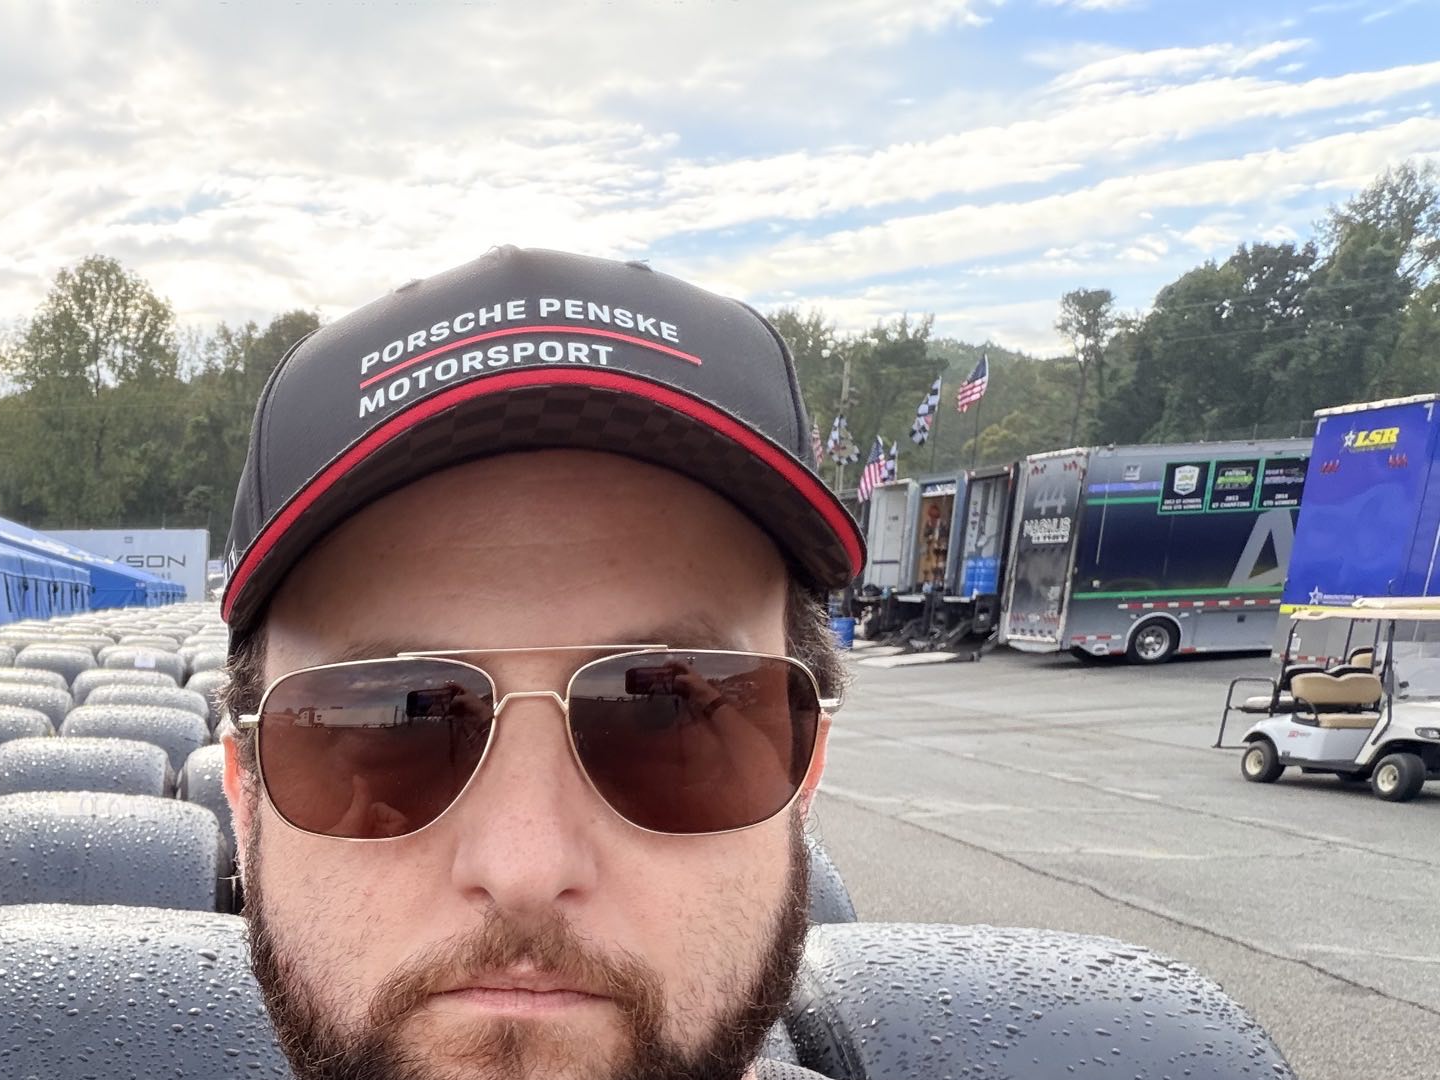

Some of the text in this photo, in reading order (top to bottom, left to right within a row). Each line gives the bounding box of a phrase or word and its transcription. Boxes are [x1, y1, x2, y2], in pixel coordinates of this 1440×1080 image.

[361, 298, 679, 375] PORSCHE PENSKE
[359, 341, 613, 417] MOTORSPORT
[1354, 427, 1400, 448] LSR
